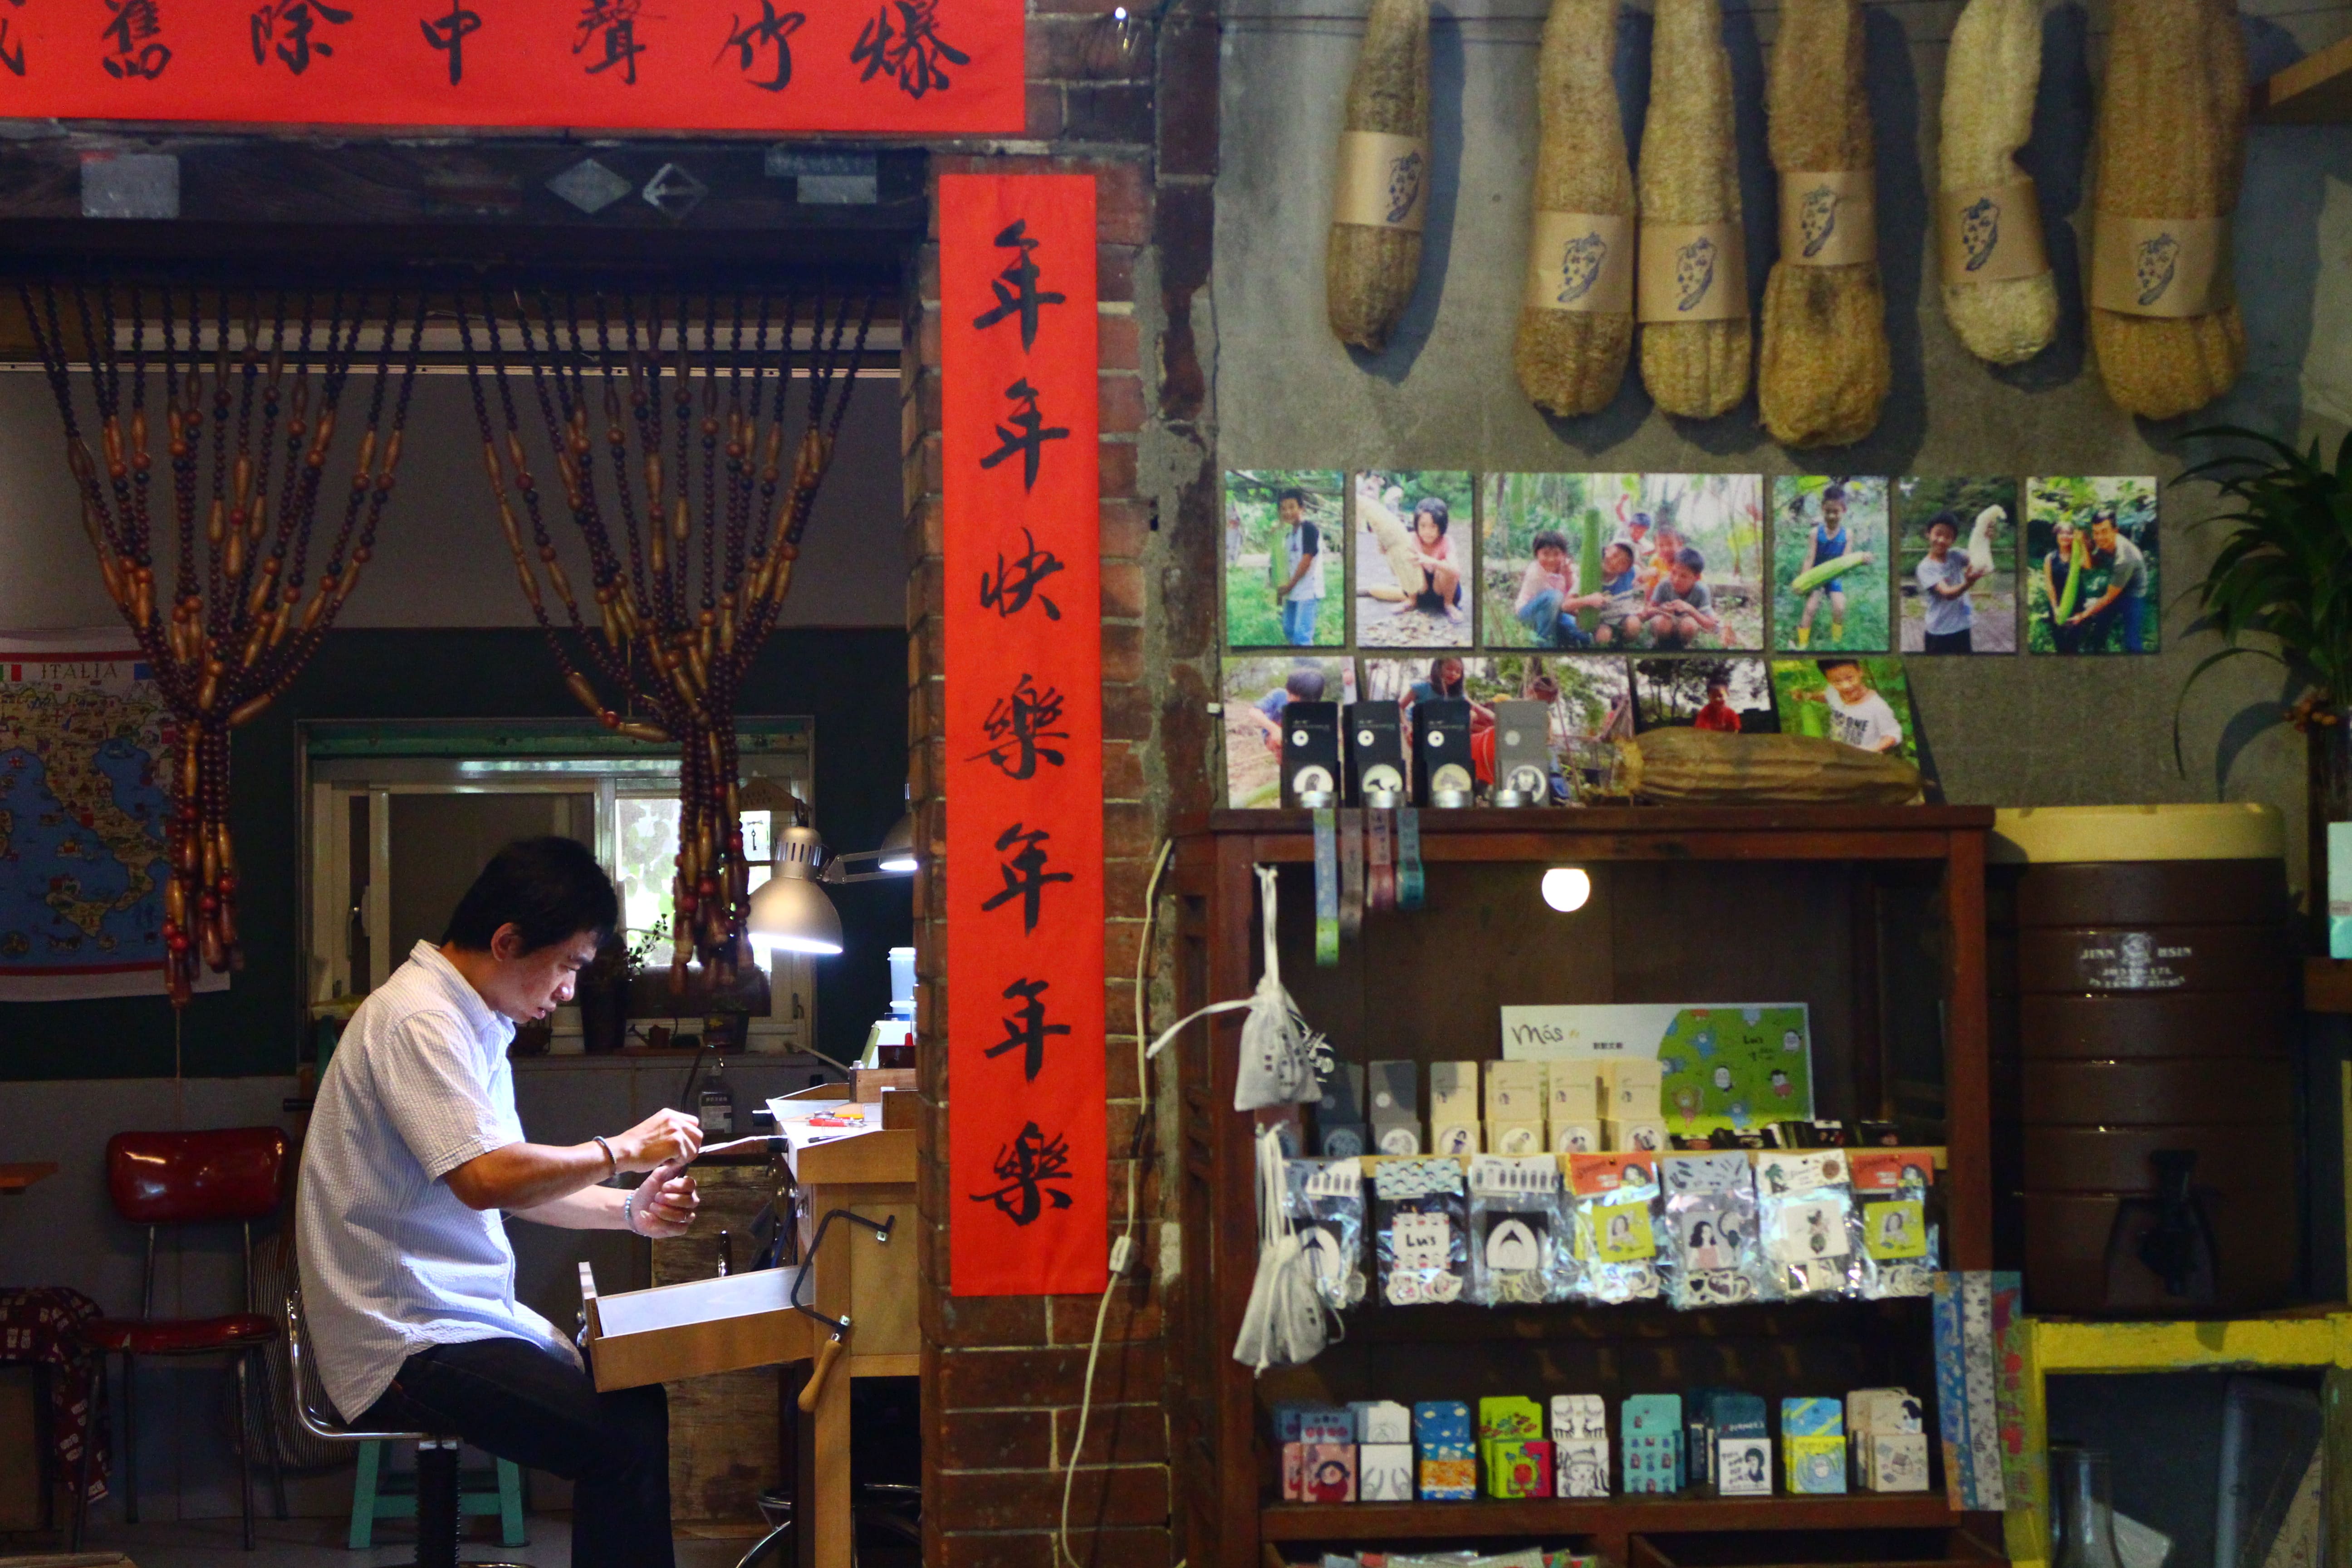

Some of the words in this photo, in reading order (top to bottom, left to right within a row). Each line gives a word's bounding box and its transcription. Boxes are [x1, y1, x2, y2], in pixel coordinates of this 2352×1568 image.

[41, 663, 118, 680] ITALIA
[965, 219, 1074, 1227] 年年快樂年年樂
